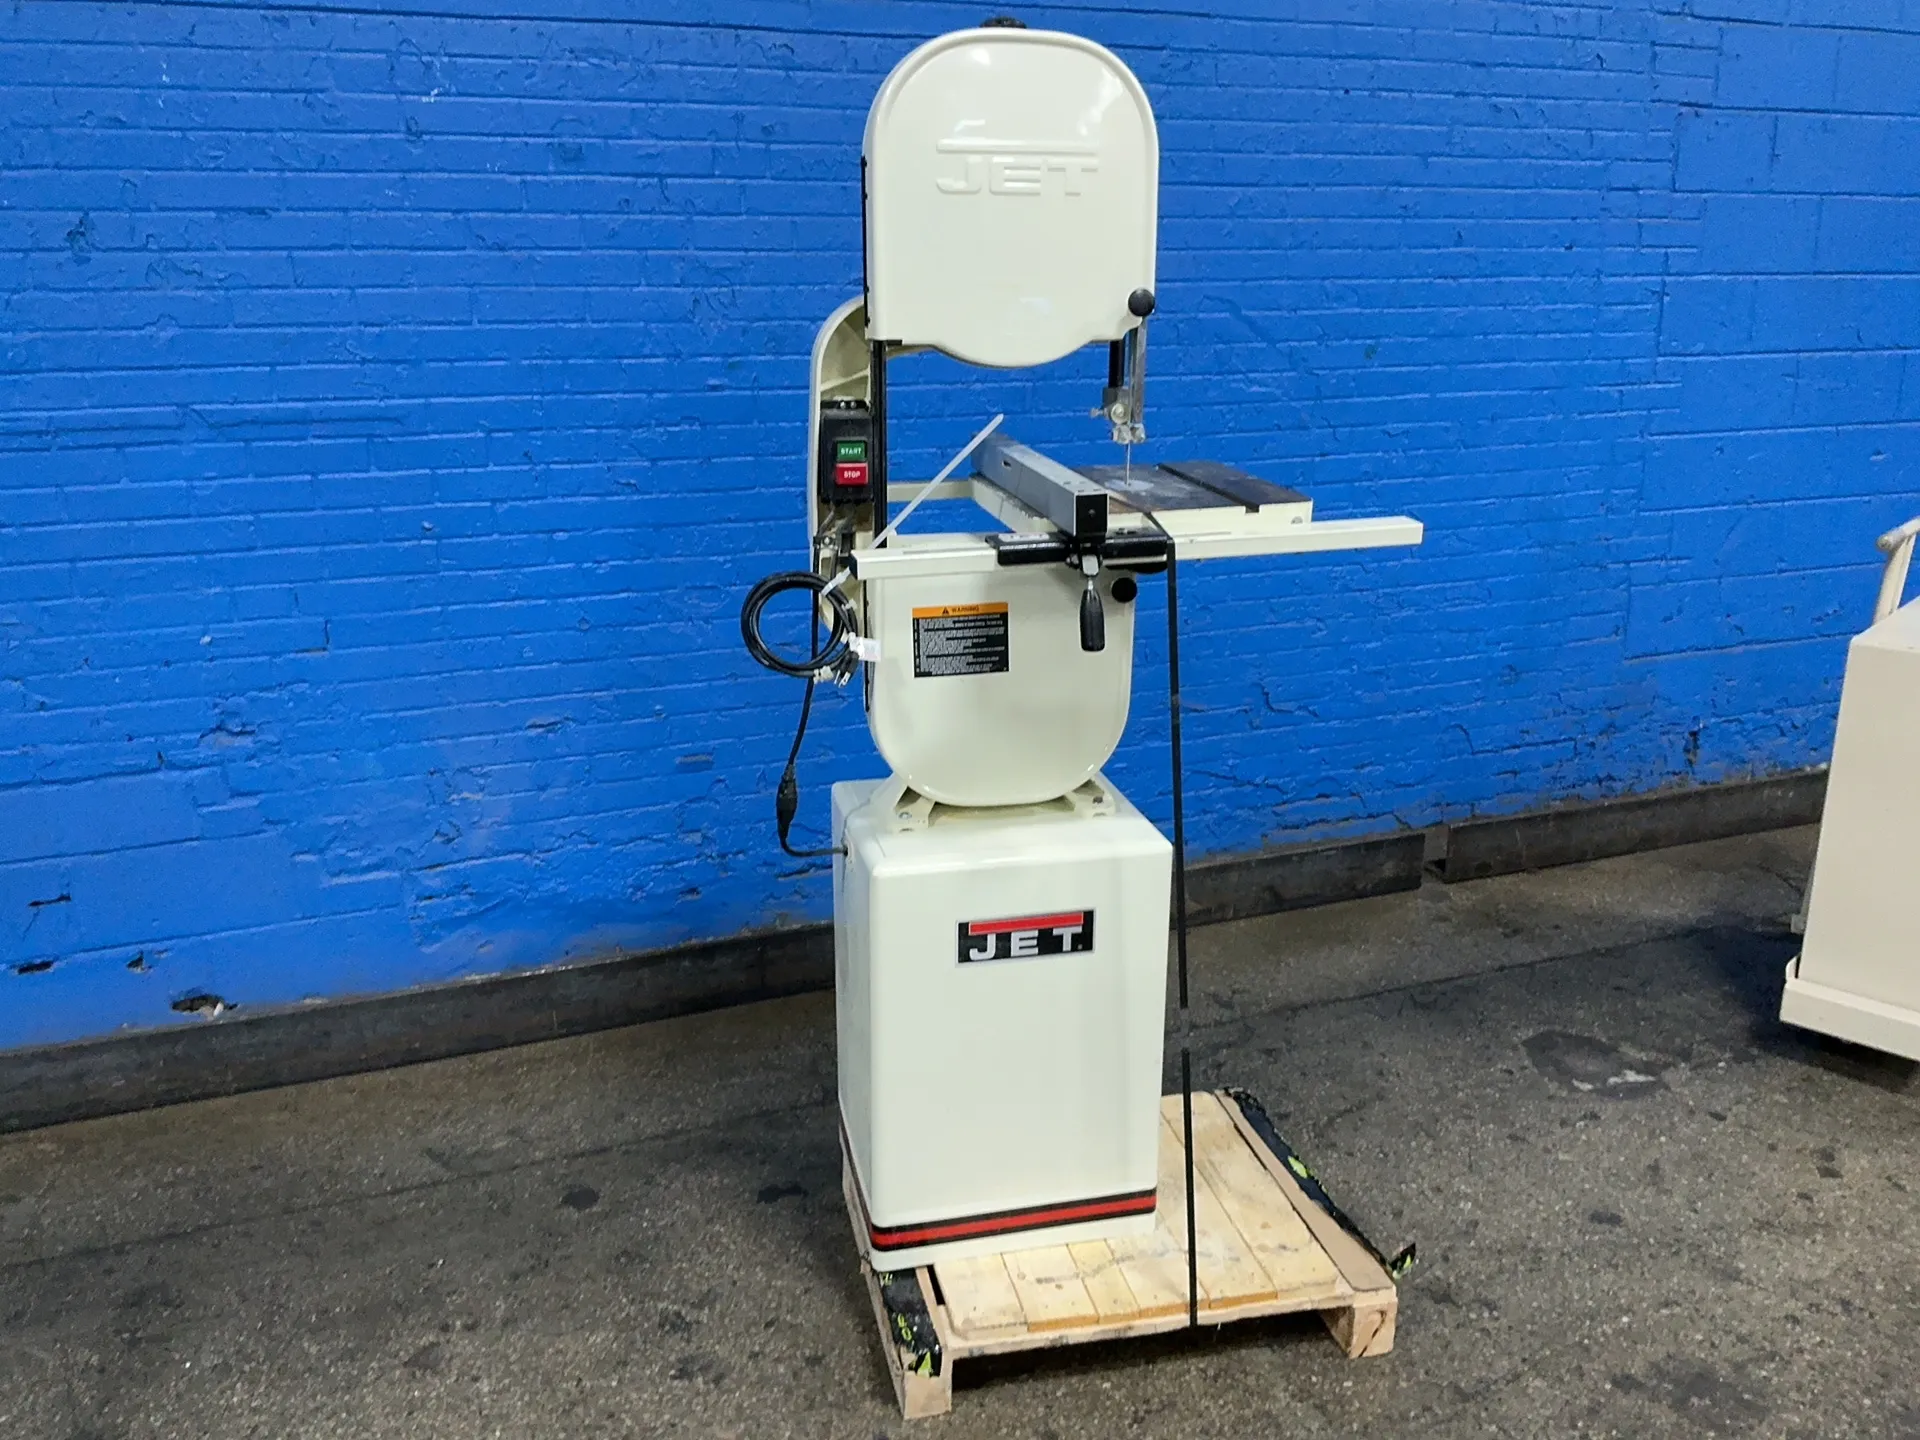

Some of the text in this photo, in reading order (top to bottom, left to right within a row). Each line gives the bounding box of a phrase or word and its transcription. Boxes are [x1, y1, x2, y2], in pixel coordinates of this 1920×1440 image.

[935, 154, 1099, 196] JET
[840, 447, 862, 455] START
[843, 470, 861, 479] STOP
[969, 925, 1083, 961] JET
